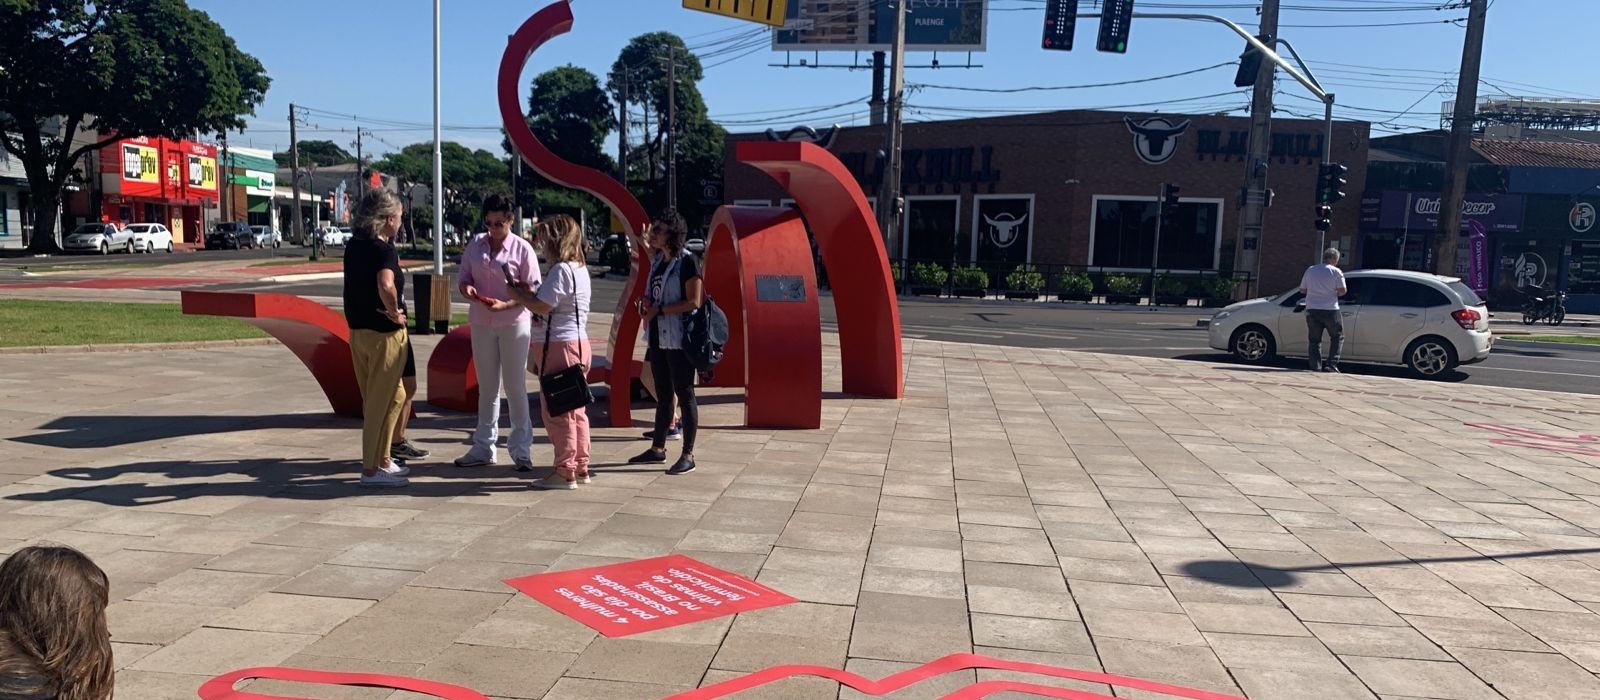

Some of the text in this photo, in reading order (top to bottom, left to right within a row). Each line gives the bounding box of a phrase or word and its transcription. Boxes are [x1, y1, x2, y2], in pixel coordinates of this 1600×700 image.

[923, 146, 1000, 183] BULL
[591, 574, 679, 616] assassinadas
[651, 574, 673, 585] de
[554, 587, 629, 624] 4 mulheres
[580, 584, 660, 620] por dia são
[677, 601, 702, 611] no
